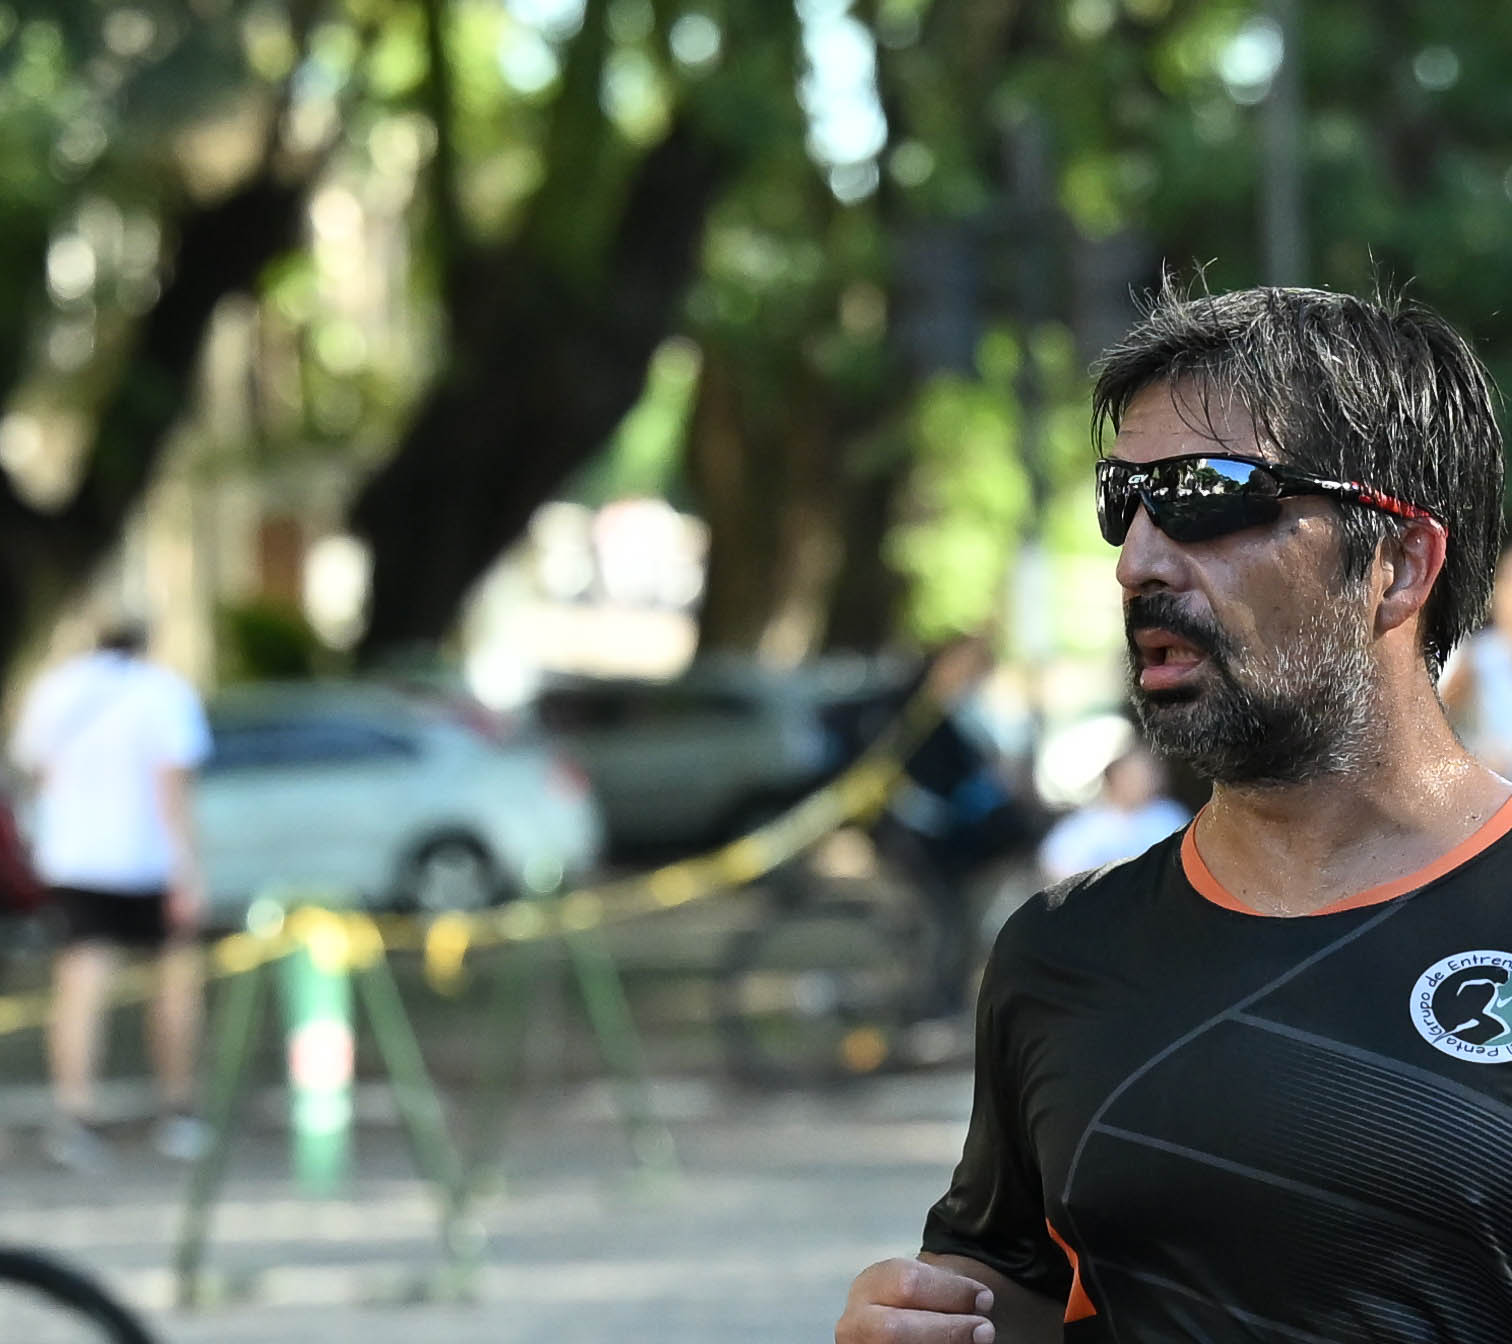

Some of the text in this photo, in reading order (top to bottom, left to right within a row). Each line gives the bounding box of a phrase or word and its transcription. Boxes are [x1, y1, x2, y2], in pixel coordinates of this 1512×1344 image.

[1425, 971, 1445, 988] de
[1420, 992, 1442, 1035] Grupo
[1446, 1037, 1499, 1057] Penta
